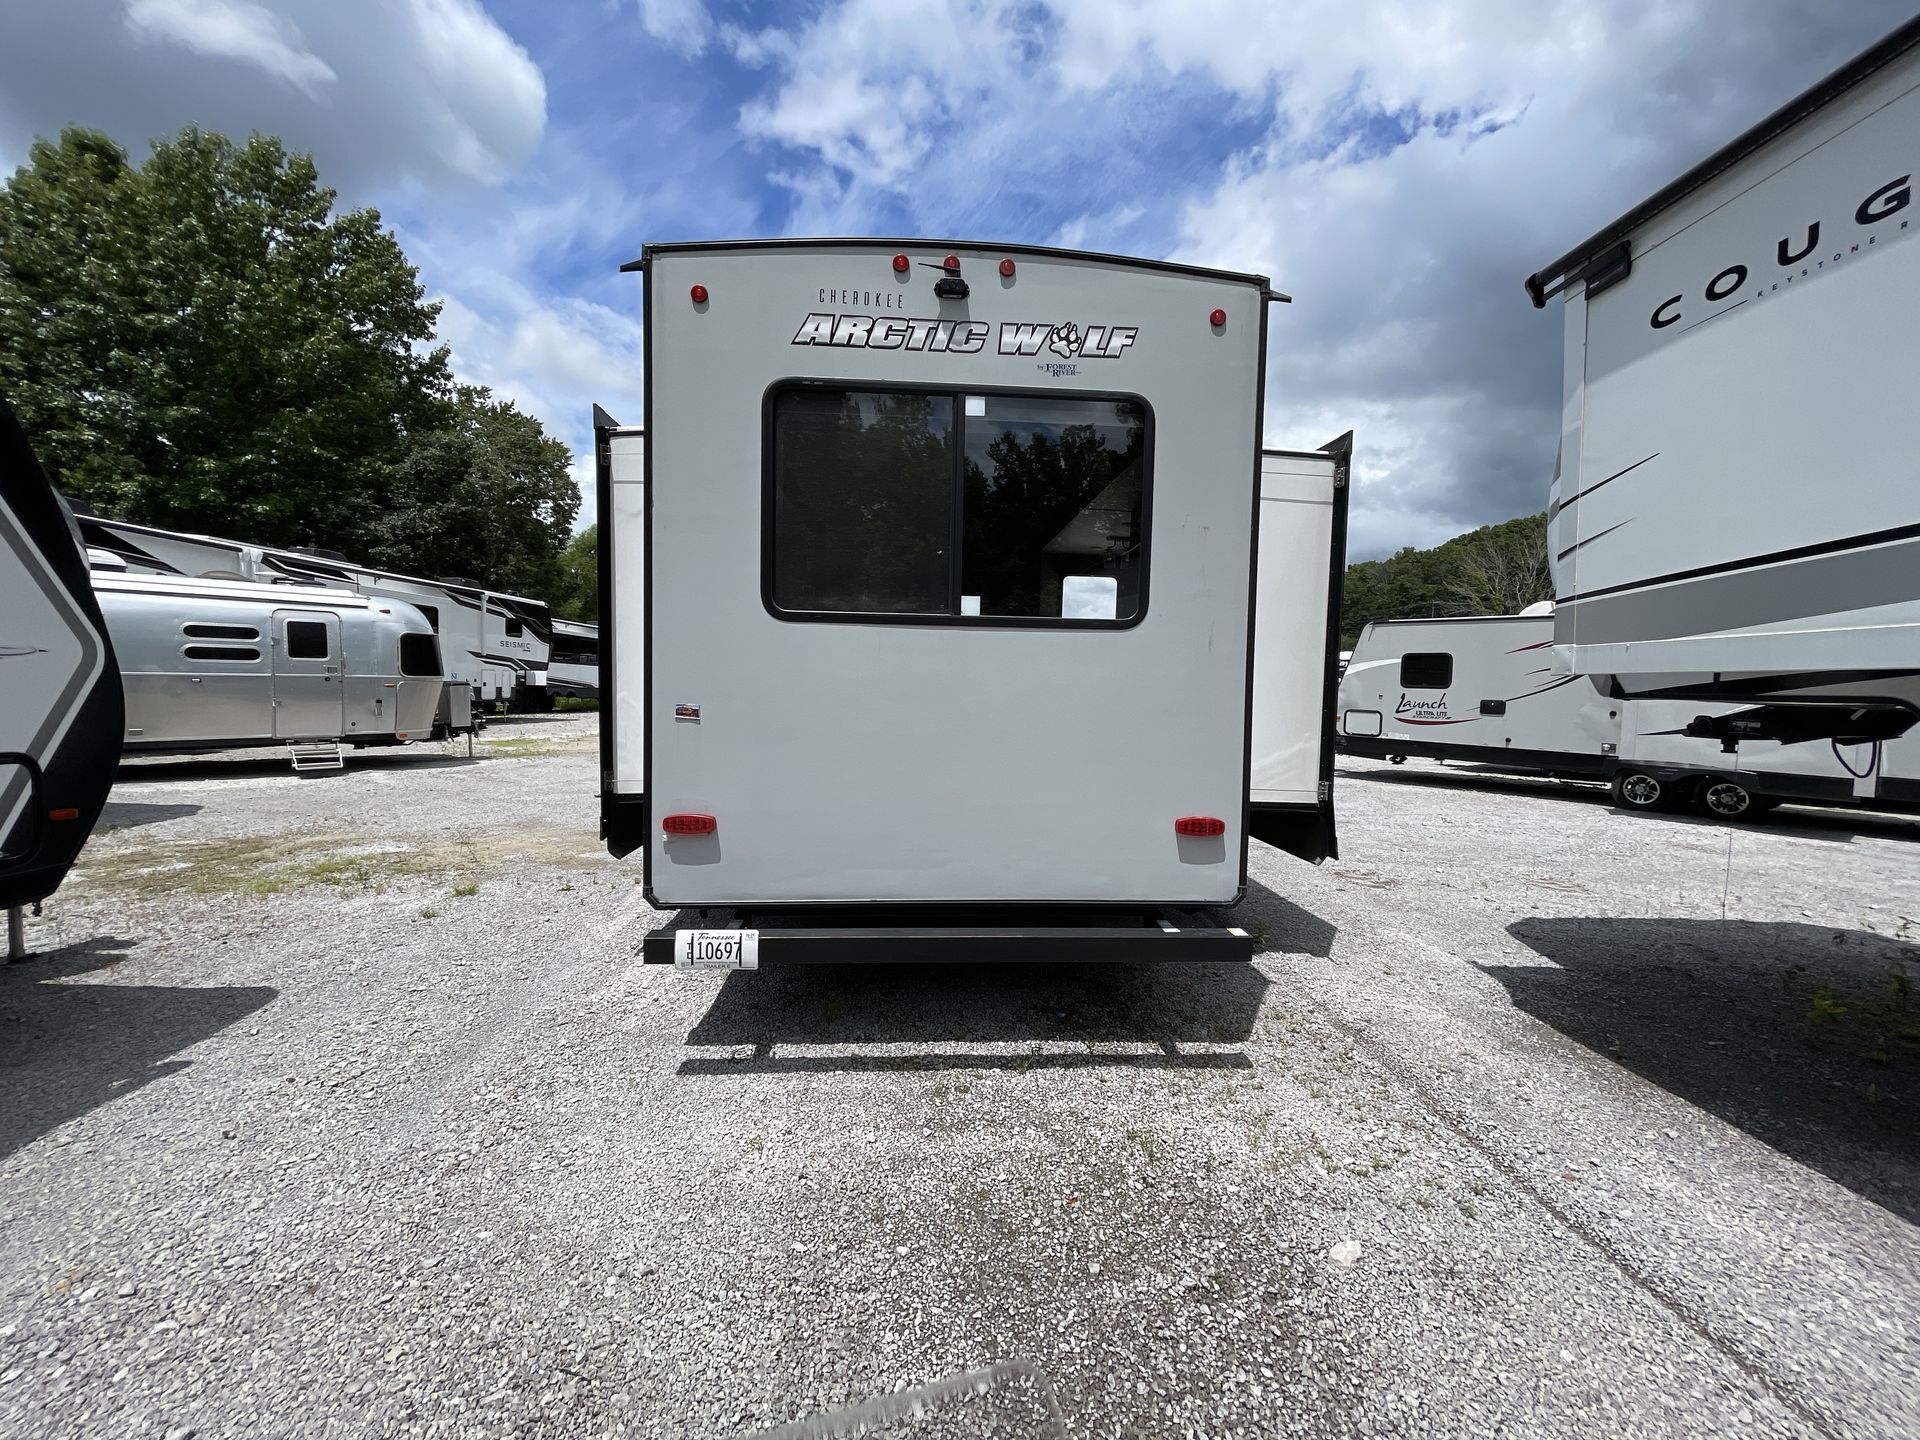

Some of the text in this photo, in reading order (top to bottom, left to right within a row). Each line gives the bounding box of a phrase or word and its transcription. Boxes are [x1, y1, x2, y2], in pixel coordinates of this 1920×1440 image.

[1757, 235, 1876, 298] KEYSTONE
[819, 288, 904, 309] CHEROKEE
[791, 312, 990, 354] ARCTIC
[1046, 363, 1078, 372] FOREST
[1051, 368, 1077, 378] RIVER
[500, 640, 531, 650] SEISMIC
[1395, 692, 1449, 714] Launch
[698, 932, 736, 941] Tennessee
[696, 941, 741, 960] 10697
